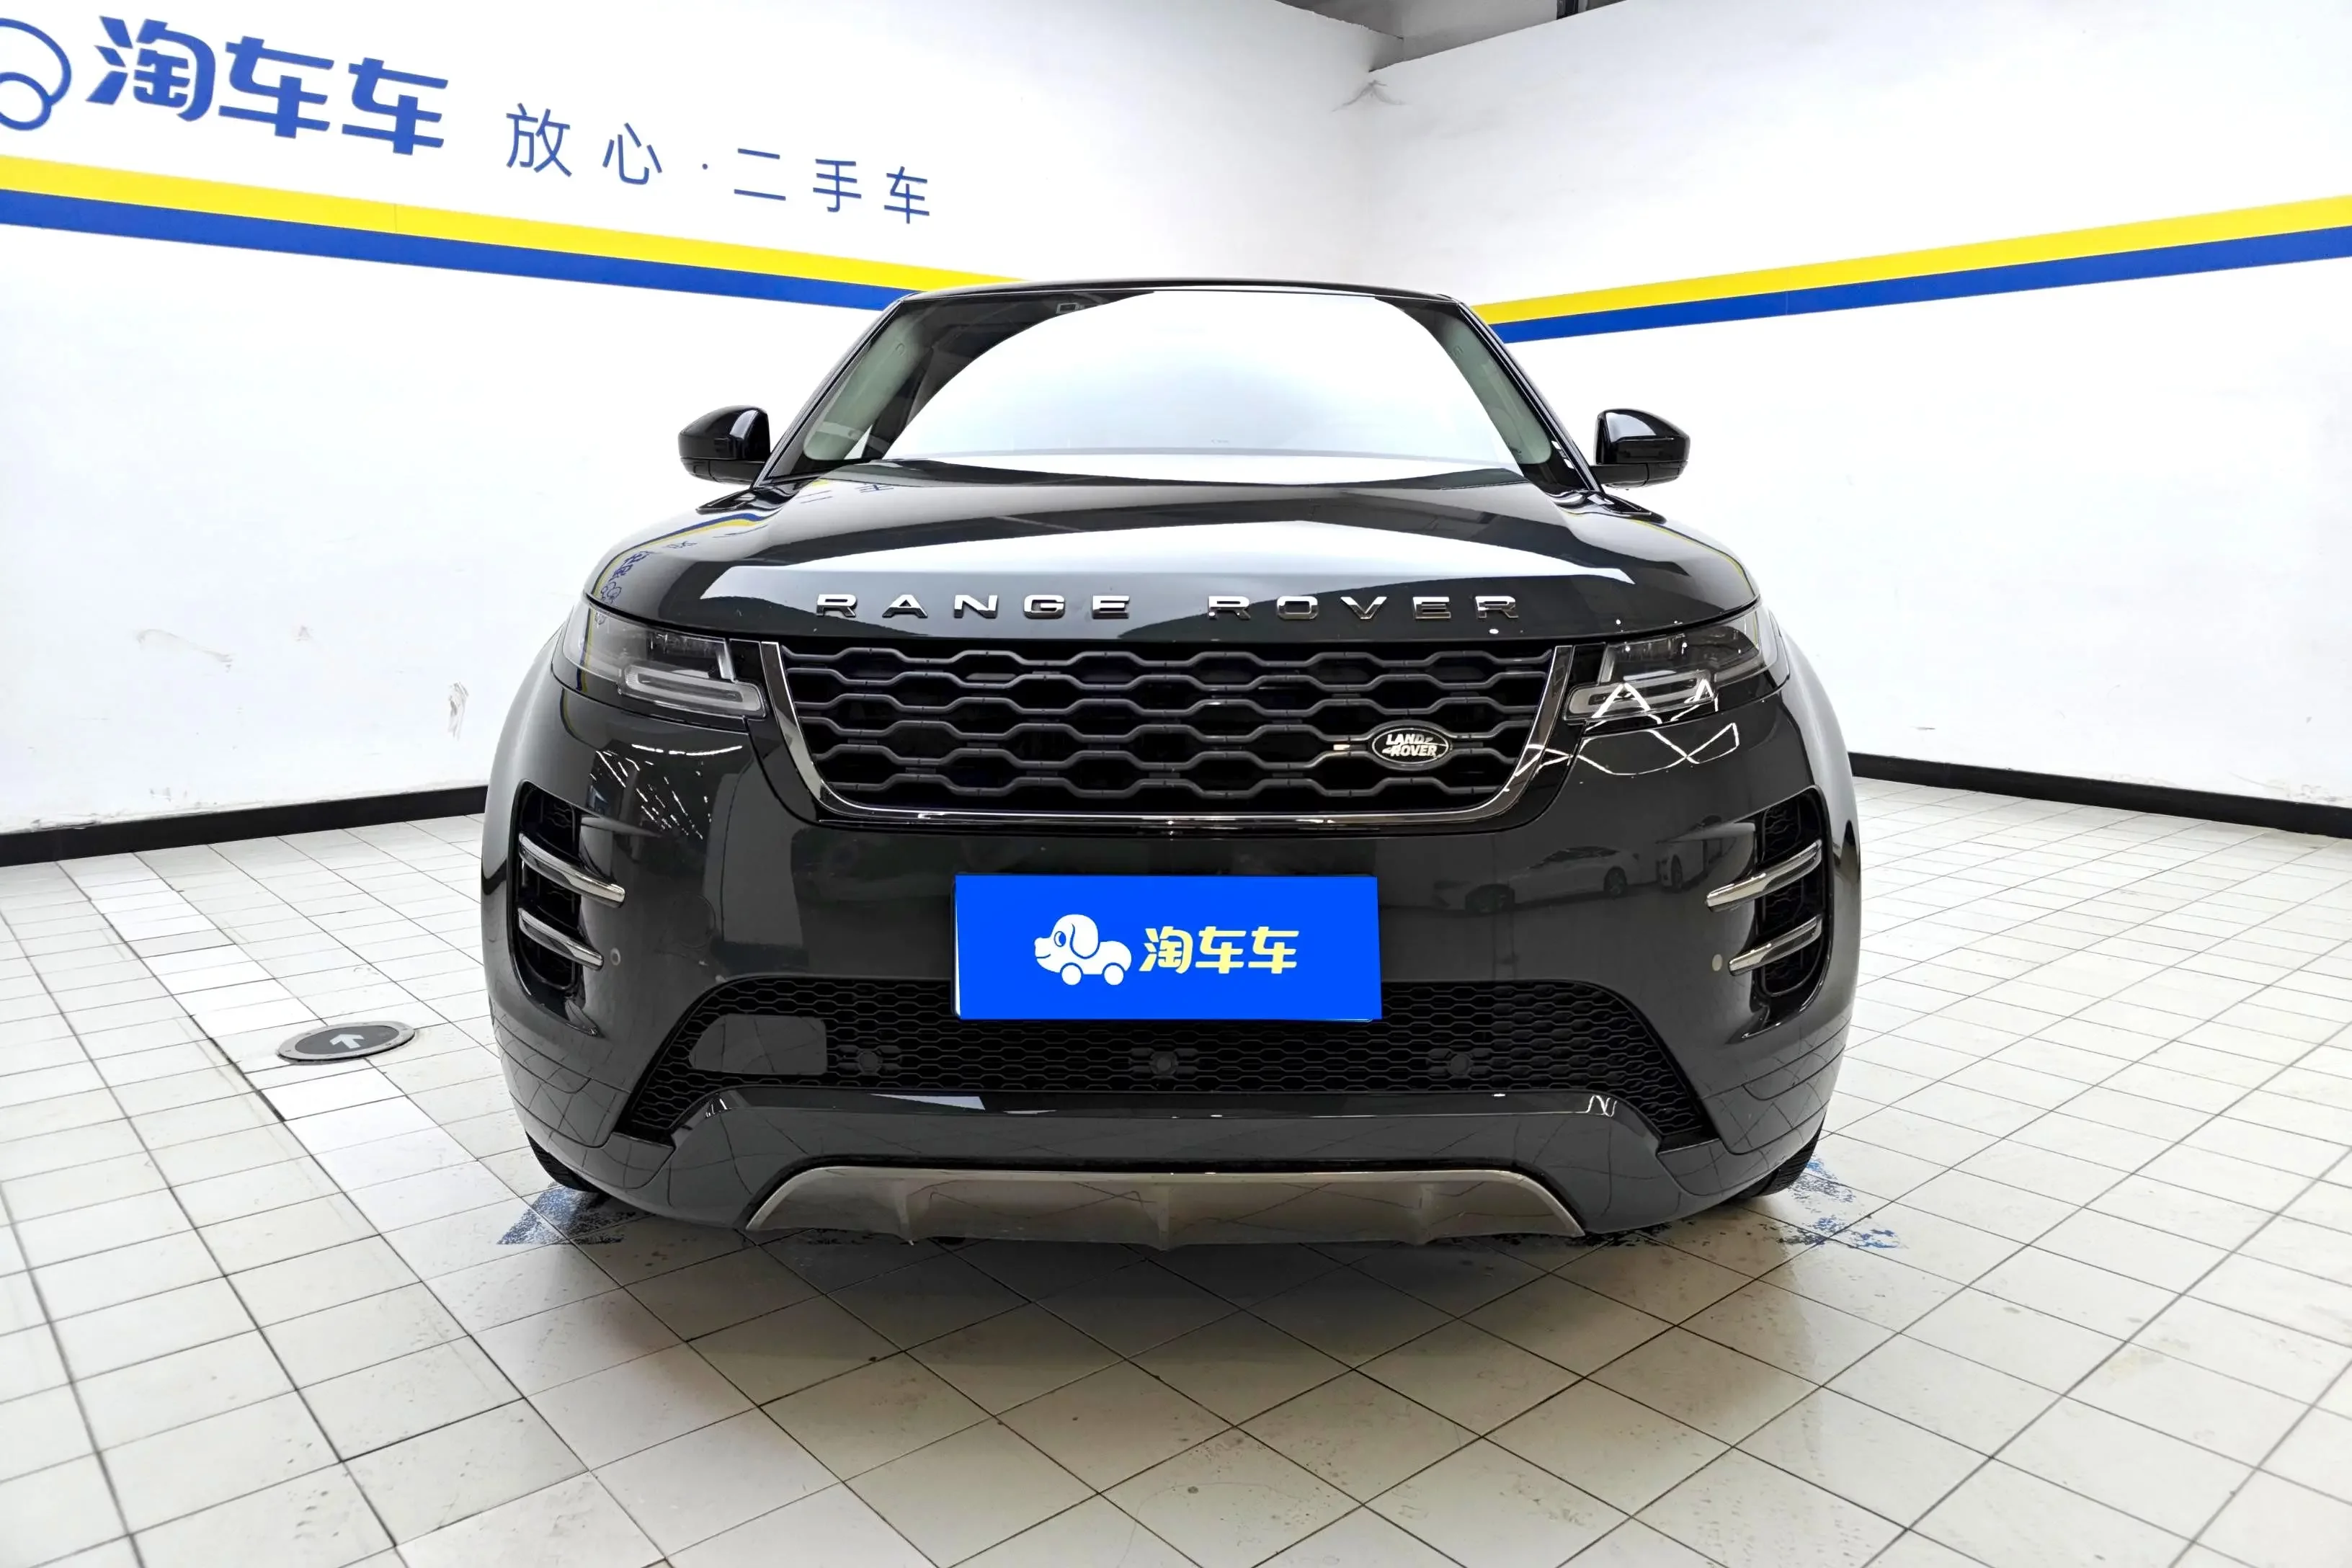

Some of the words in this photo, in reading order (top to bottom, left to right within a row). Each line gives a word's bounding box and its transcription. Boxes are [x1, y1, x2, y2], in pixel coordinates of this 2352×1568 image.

[85, 15, 449, 156] 淘车车
[815, 593, 1130, 620] RANGE
[1208, 595, 1519, 620] ROVER
[1386, 734, 1427, 746] LAND
[1389, 744, 1438, 757] ROVER
